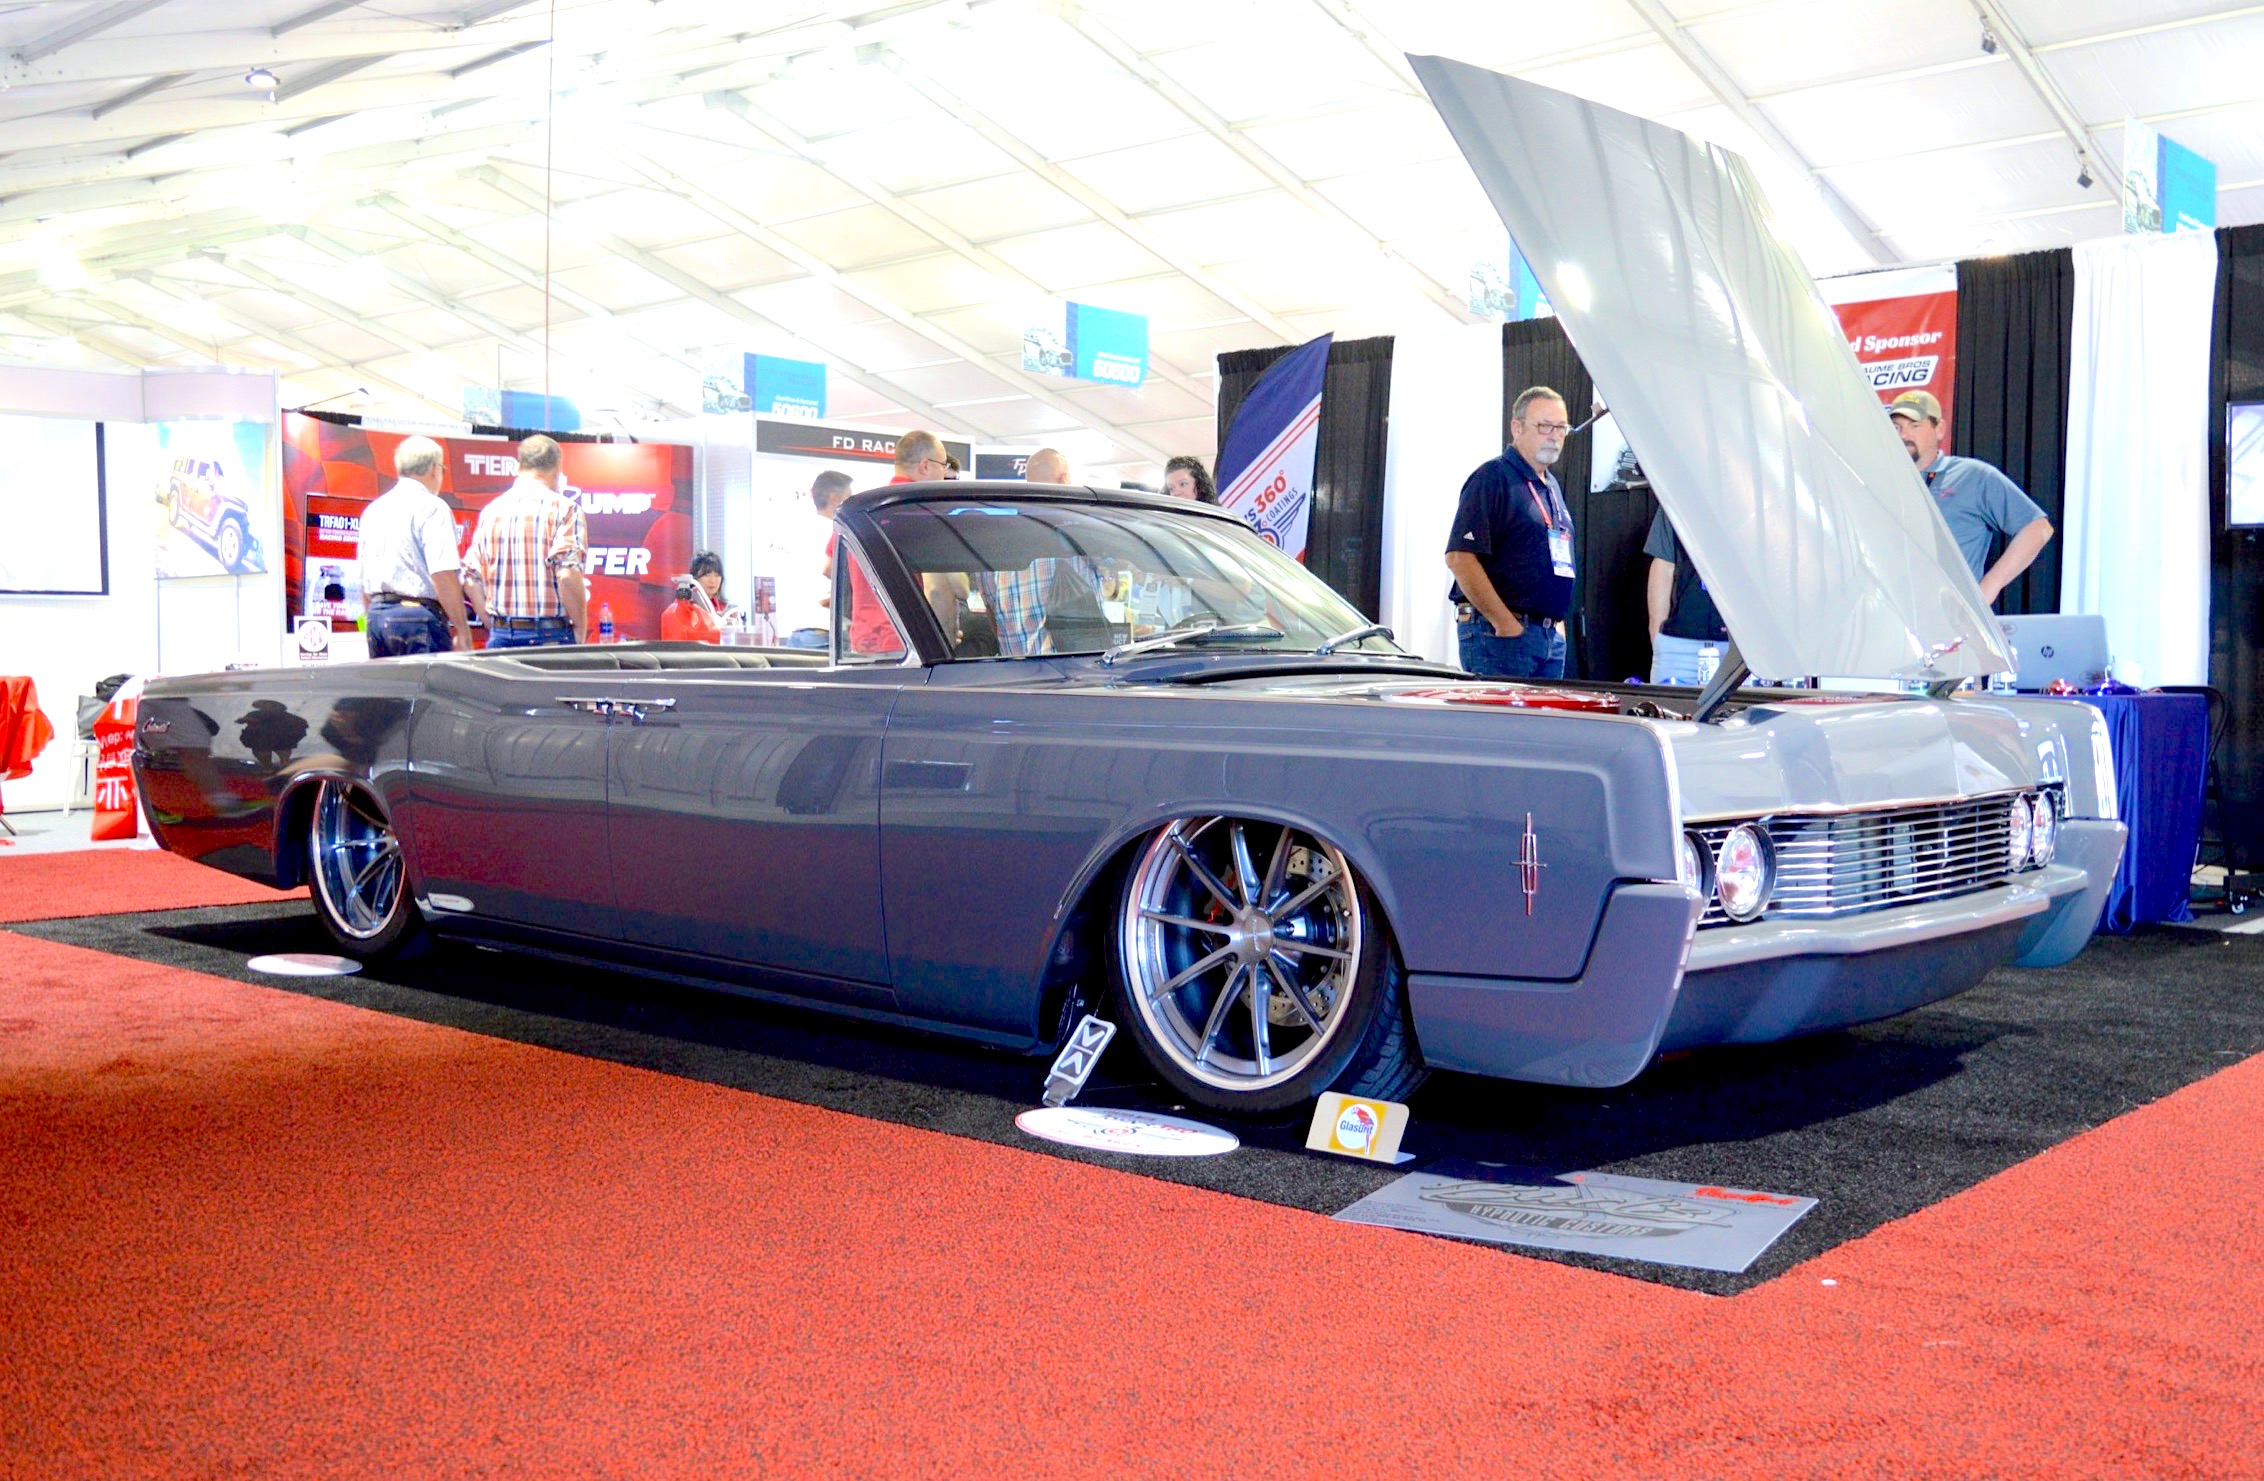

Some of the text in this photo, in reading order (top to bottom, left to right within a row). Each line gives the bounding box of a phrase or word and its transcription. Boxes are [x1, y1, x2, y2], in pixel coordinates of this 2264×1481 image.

[1864, 331, 1943, 354] Sponsor
[1898, 360, 1931, 370] BROS
[1867, 368, 1929, 386] CING
[832, 435, 896, 454] FD RAC
[464, 454, 519, 476] TER
[1266, 487, 1298, 522] COATINGS
[2041, 645, 2055, 659] hp
[1340, 1119, 1374, 1135] Glasurit
[1469, 1204, 1556, 1226] HYPNOTIC
[1558, 1218, 1655, 1236] CUSTOMS
